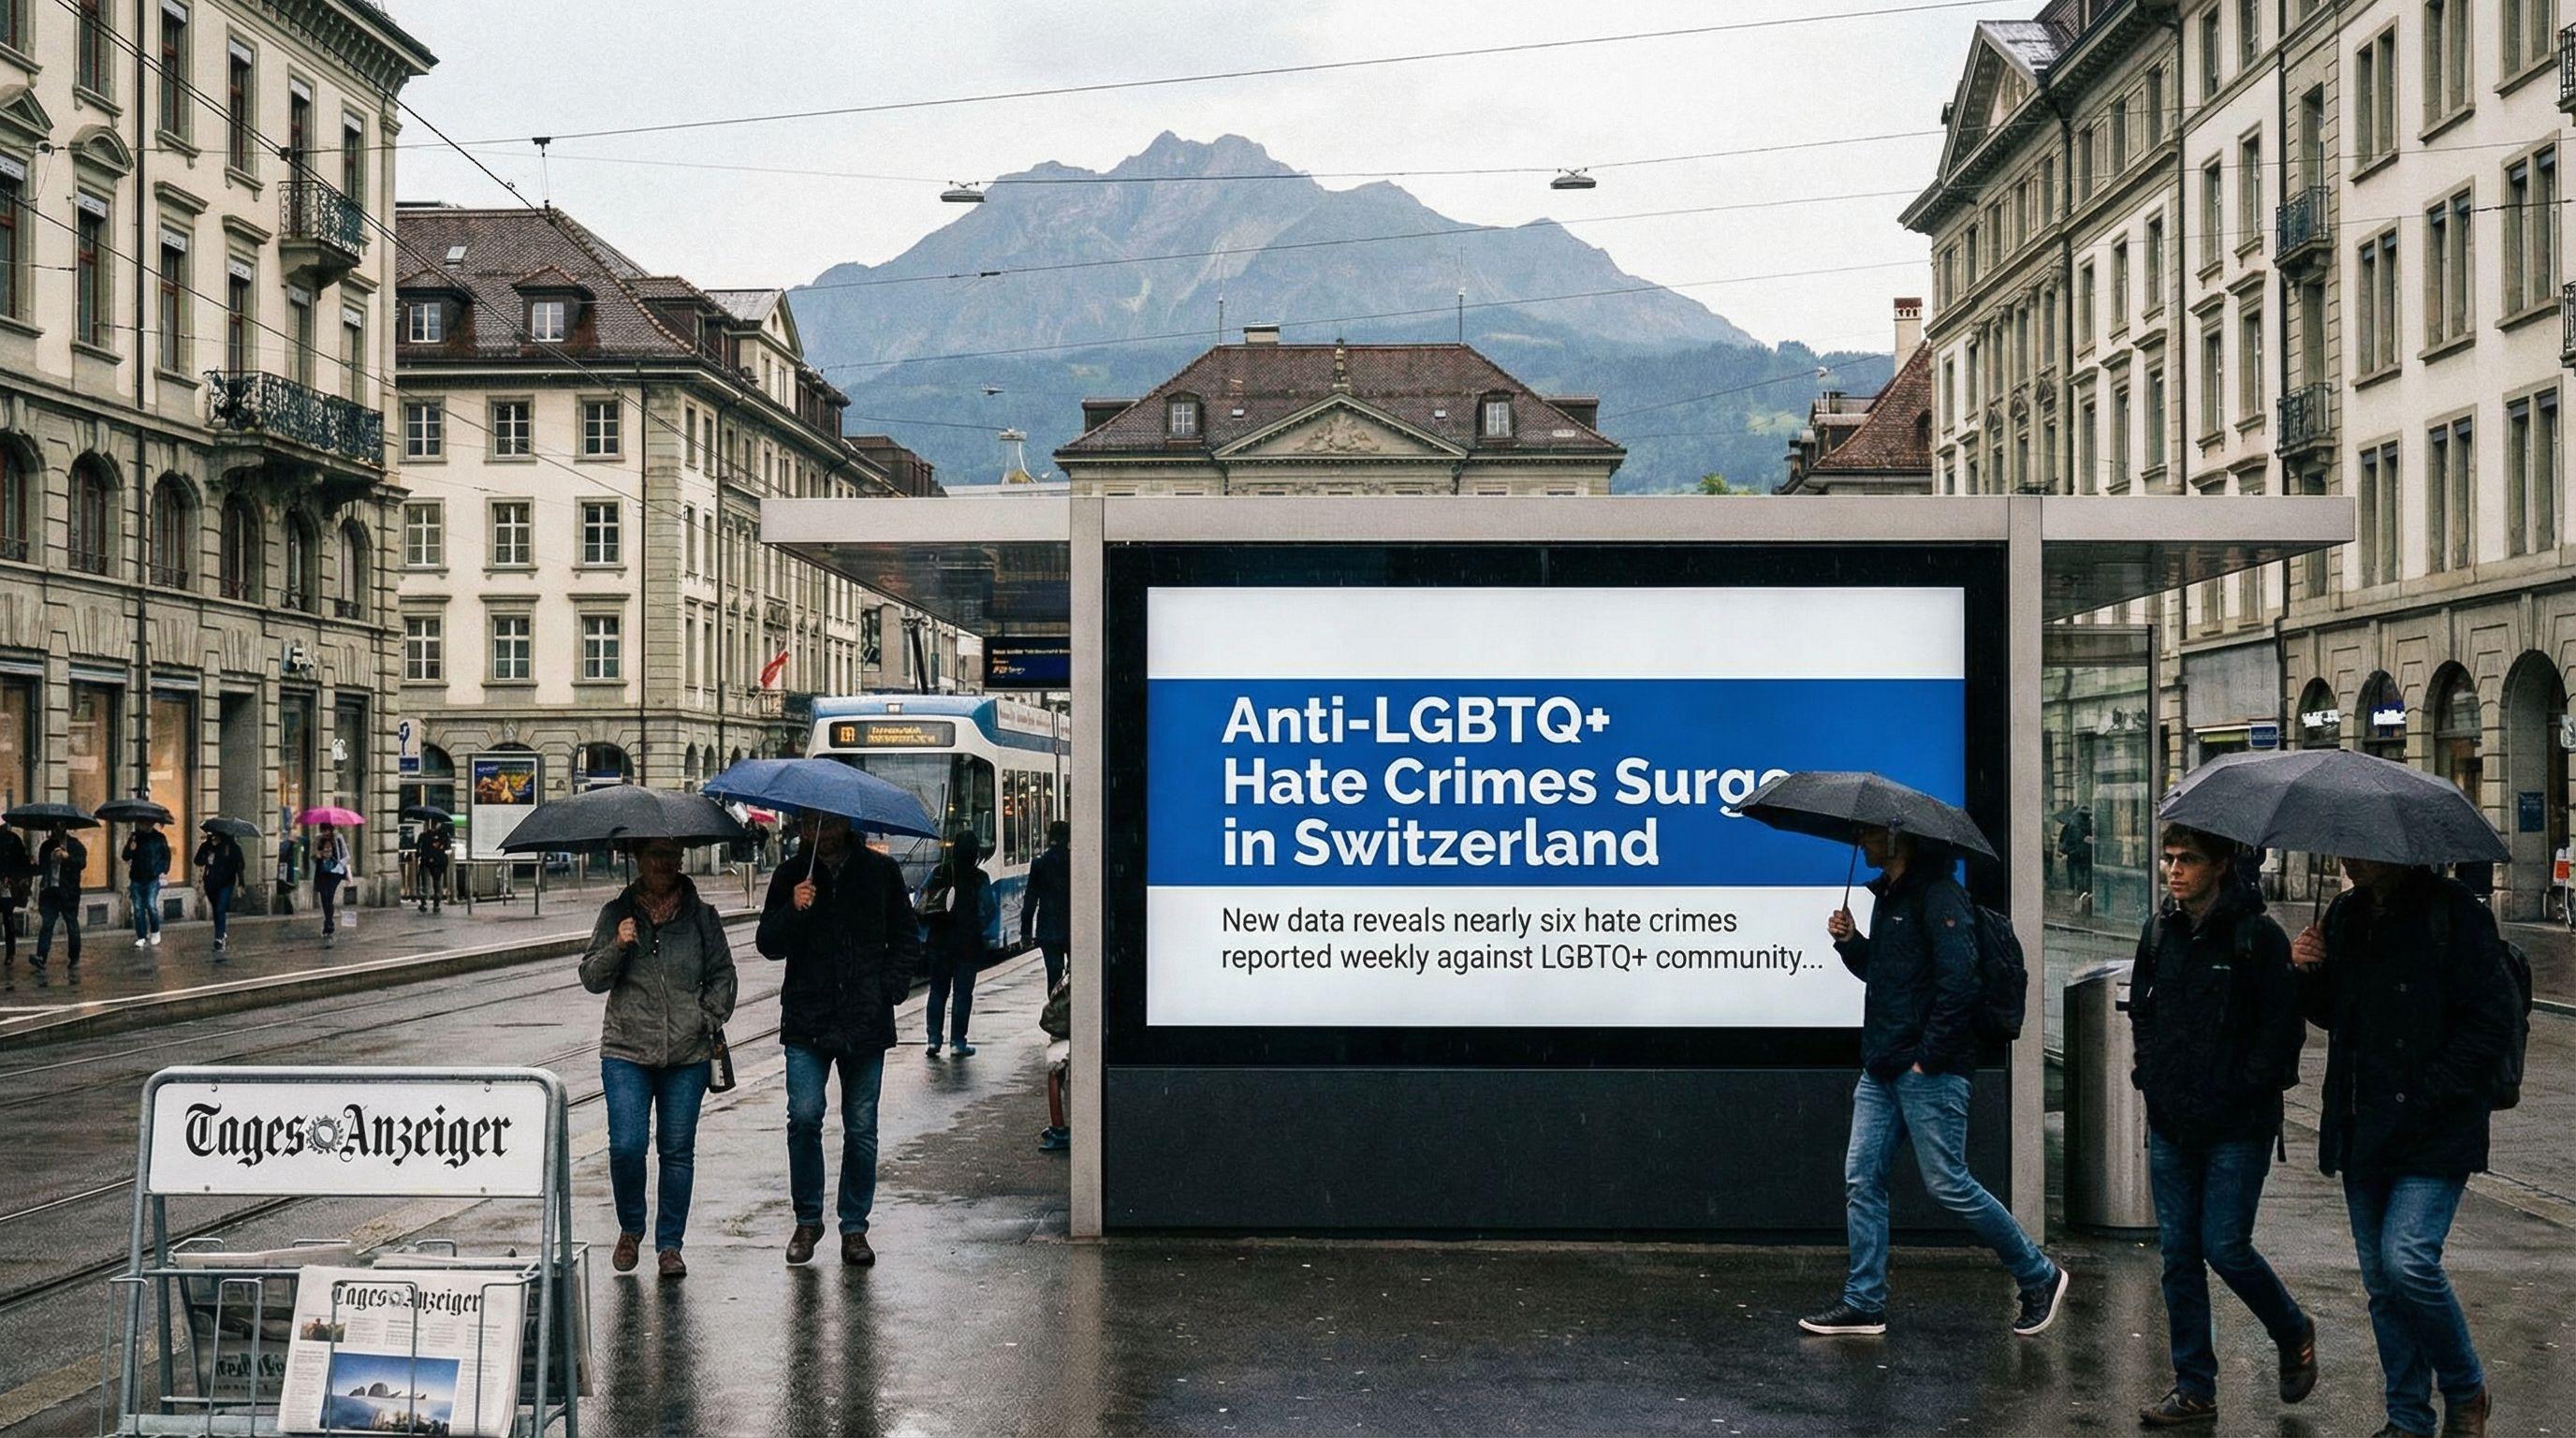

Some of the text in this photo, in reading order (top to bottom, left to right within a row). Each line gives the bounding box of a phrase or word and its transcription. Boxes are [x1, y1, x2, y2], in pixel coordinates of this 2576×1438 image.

[1222, 696, 1610, 743] Anti-LGBTQ+
[1224, 756, 1791, 818] Hate Crimes Surg
[1224, 817, 1660, 866] in Switzerland
[1222, 906, 1737, 939] New data reveals nearly six hate crimes
[1222, 943, 1823, 976] reported weekly against LGBTQ+ community...
[185, 1103, 513, 1169] Tages Anzeiger
